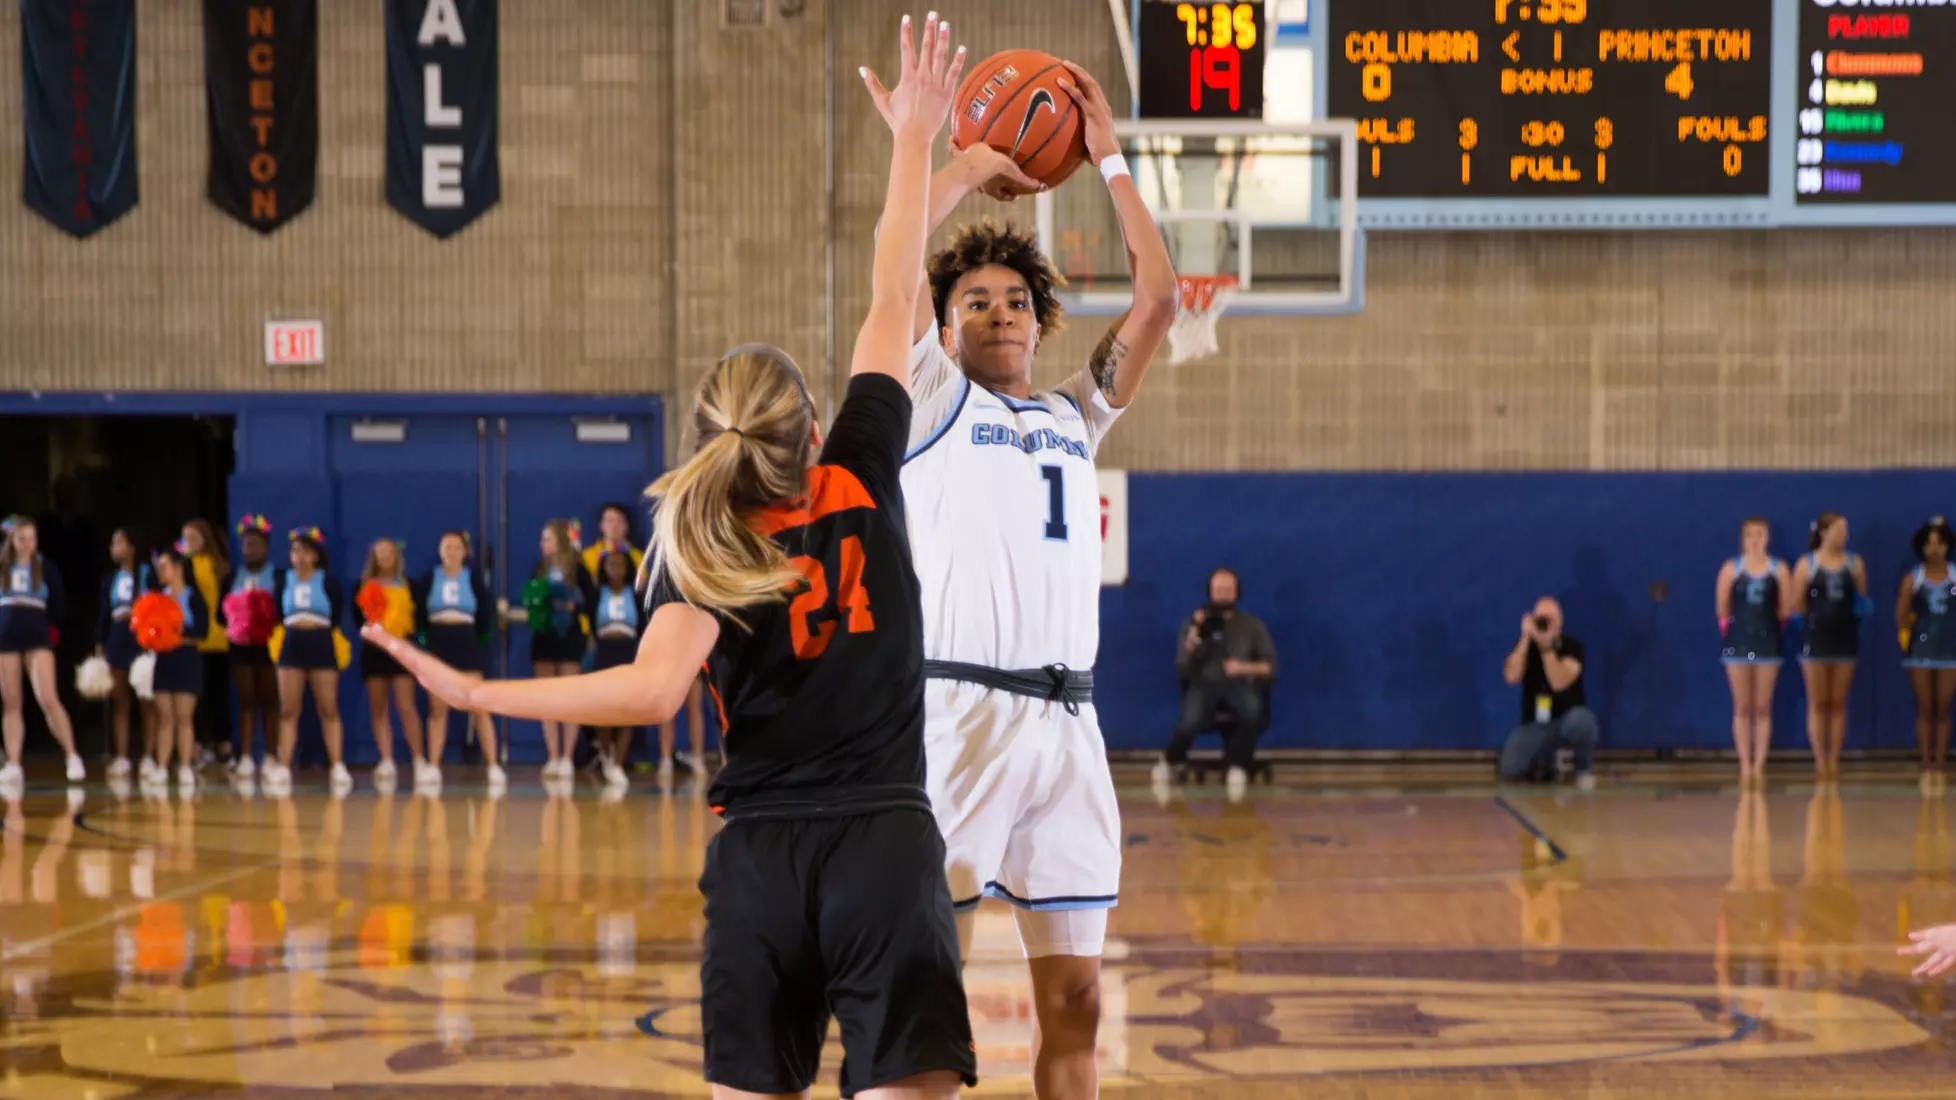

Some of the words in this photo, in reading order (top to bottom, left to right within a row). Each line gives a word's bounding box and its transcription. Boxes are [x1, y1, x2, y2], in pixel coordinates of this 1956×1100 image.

[1176, 3, 1257, 50] 7:35
[1345, 30, 1478, 63] COLUMBIA
[1599, 28, 1750, 62] PRINCETON
[1189, 43, 1241, 112] 19
[1362, 62, 1391, 102] 0
[1501, 68, 1593, 94] BONUS
[1664, 61, 1694, 100] 4
[416, 0, 466, 207] ALE
[1678, 115, 1767, 142] FOULS
[1510, 154, 1581, 182] FULL
[273, 327, 317, 361] EXIT
[1039, 463, 1070, 542] 1
[777, 534, 876, 661] 24
